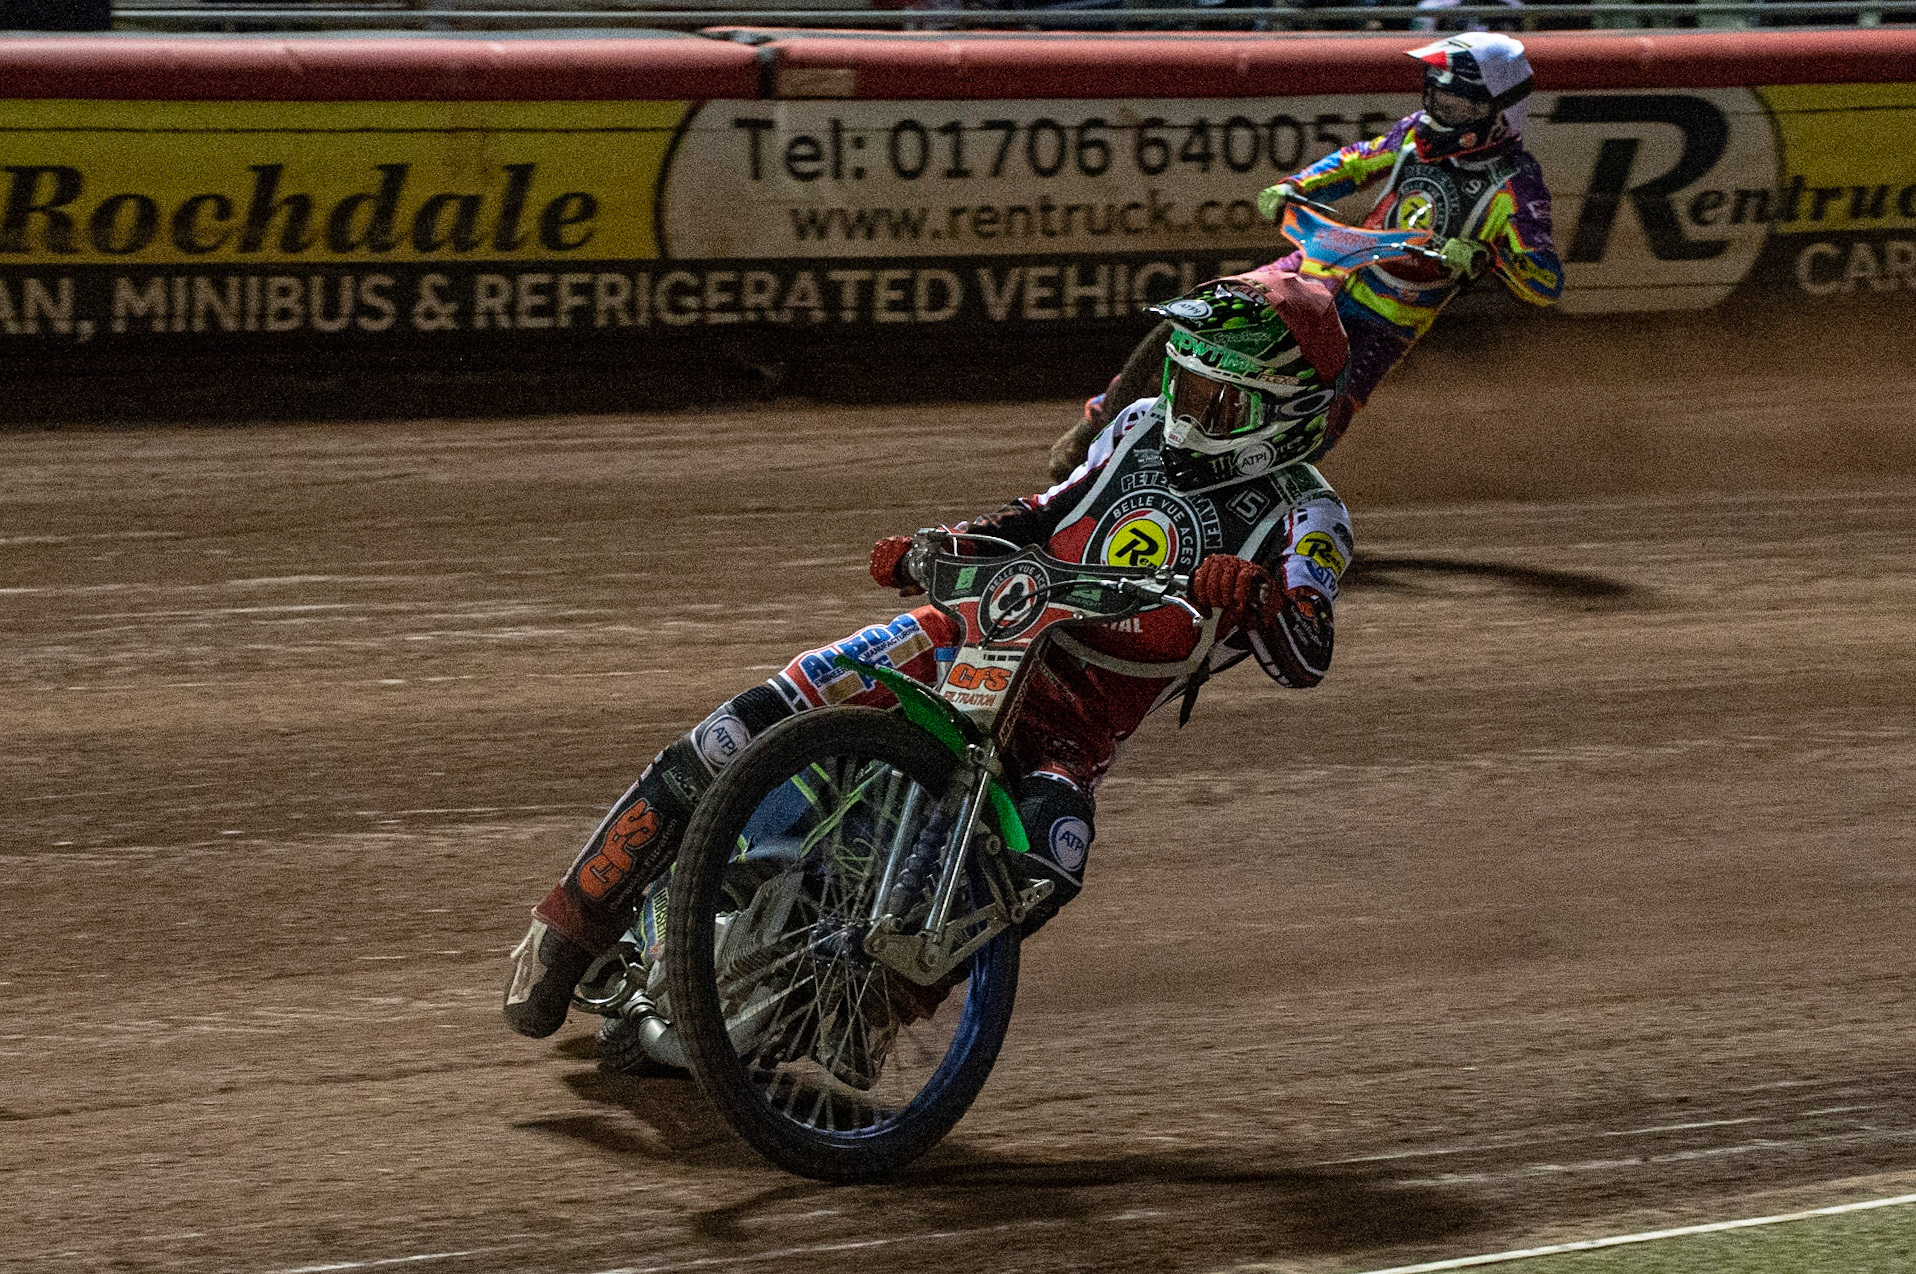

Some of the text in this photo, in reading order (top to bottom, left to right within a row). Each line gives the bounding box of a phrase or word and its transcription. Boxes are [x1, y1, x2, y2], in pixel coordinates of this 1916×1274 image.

[733, 118, 865, 181] Tel:
[890, 117, 1111, 179] 01706
[2, 163, 600, 257] Rochdale
[790, 191, 1258, 241] www.rentruck.co
[112, 275, 398, 333] MINIBUS
[412, 273, 458, 331] &
[474, 263, 962, 330] REFRIGERATED
[1241, 452, 1268, 469] ATPI
[1120, 469, 1178, 493] PETE
[1112, 495, 1204, 566] BELLE VUE ACES
[988, 567, 1014, 592] BELLE
[1018, 564, 1036, 575] VUE
[1035, 573, 1047, 597] ACE
[864, 624, 920, 659] MANUFACTURING
[947, 662, 1012, 692] CFS
[944, 690, 997, 707] FILTRATION
[712, 726, 739, 757] ATPI
[578, 798, 664, 899] CFS
